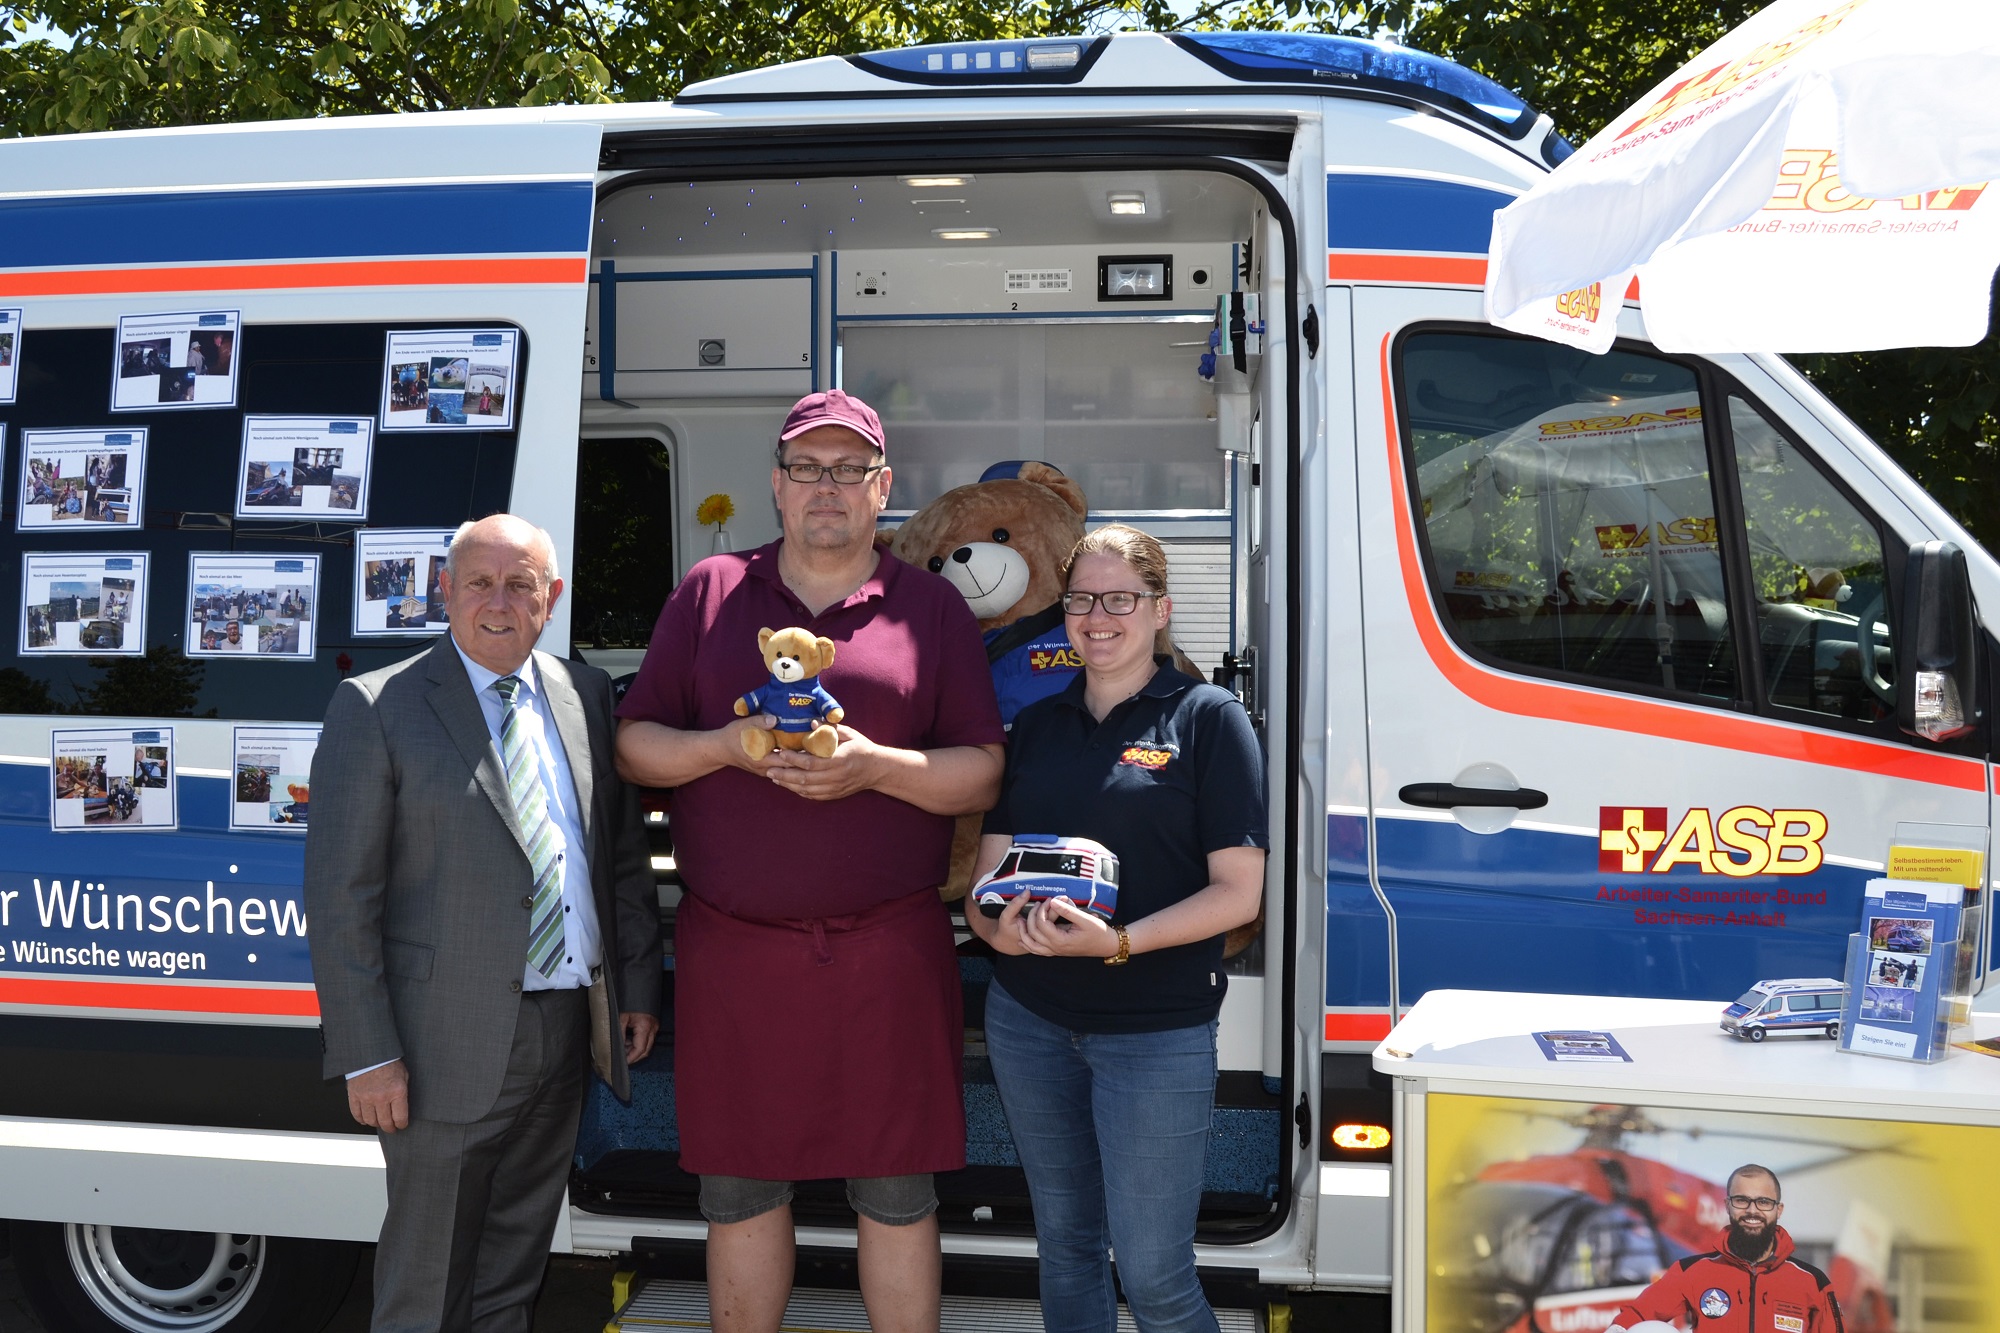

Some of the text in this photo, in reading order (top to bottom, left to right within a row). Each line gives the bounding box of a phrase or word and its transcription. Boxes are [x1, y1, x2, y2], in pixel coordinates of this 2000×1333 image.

[1011, 302, 1018, 311] 2
[590, 356, 596, 365] 6
[802, 353, 808, 362] 5
[1132, 750, 1172, 766] ASB
[1648, 804, 1828, 879] ASB
[1596, 886, 1826, 905] Arbeiter-Samariter-Bund
[1634, 908, 1786, 927] Sachsen-Anhalt
[12, 940, 120, 966] Wünsche
[127, 949, 206, 975] wagen
[1861, 1035, 1883, 1043] Steigen
